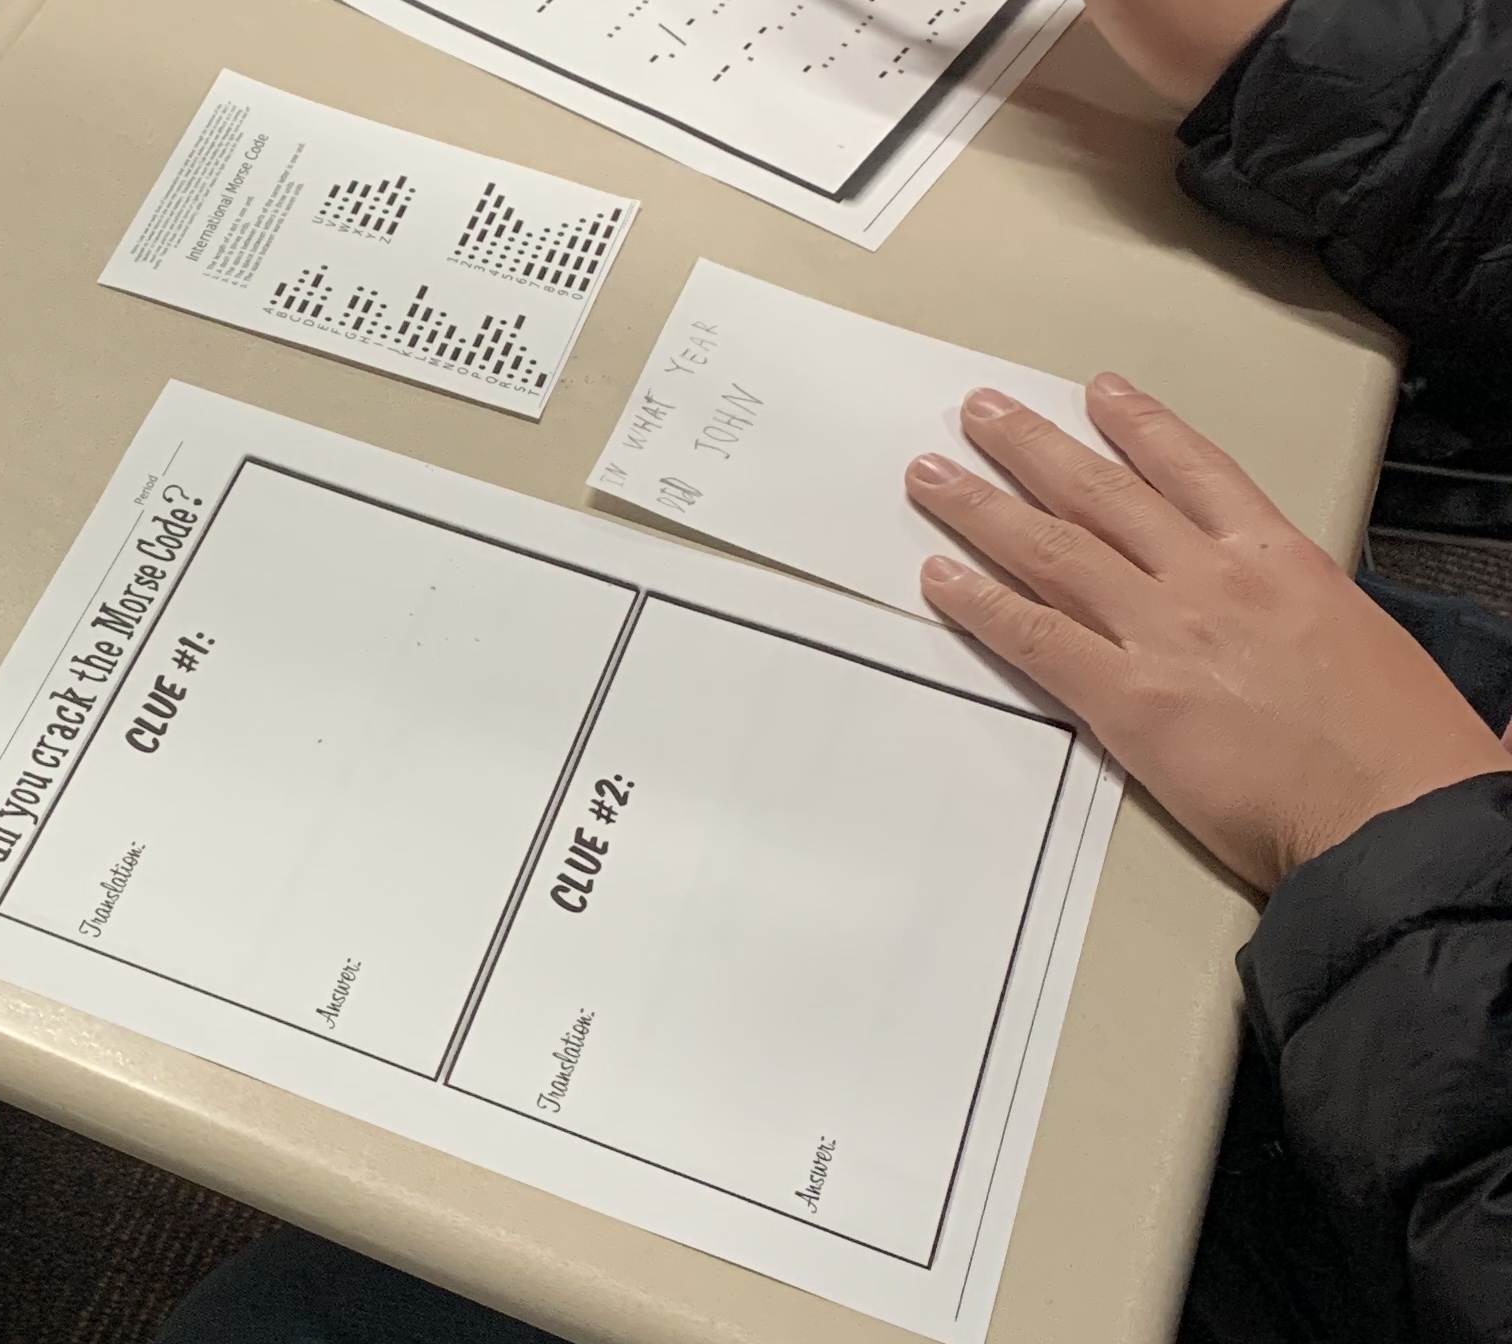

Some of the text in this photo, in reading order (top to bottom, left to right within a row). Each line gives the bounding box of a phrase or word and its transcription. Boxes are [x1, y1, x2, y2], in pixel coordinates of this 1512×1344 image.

[186, 134, 269, 261] International Morse Code
[312, 216, 324, 224] U
[338, 223, 351, 232] W
[352, 228, 364, 236] X
[379, 236, 392, 244] Z
[460, 260, 472, 268] 2
[501, 273, 513, 281] 5
[543, 285, 555, 293] 8
[276, 311, 288, 319] B
[302, 319, 315, 327] D
[345, 332, 357, 340] G
[359, 336, 371, 344] H
[428, 357, 441, 366] M
[442, 362, 455, 370] N
[485, 376, 499, 384] Q
[499, 381, 511, 389] R
[514, 385, 526, 393] S
[600, 321, 717, 487] IN WHAT YEAR
[694, 383, 763, 459] JOHN
[134, 474, 158, 505] Period
[137, 485, 202, 561] Code?
[92, 565, 166, 639] Morse
[70, 641, 123, 682] the
[126, 632, 215, 753] CLUE #1:
[32, 688, 96, 767] crack
[0, 772, 52, 825] you
[551, 775, 634, 913] CLUE #2:
[79, 842, 145, 937] Translation:
[316, 958, 361, 1029] Answer:
[537, 1009, 594, 1112] Translation:
[795, 1137, 836, 1213] Answer:
